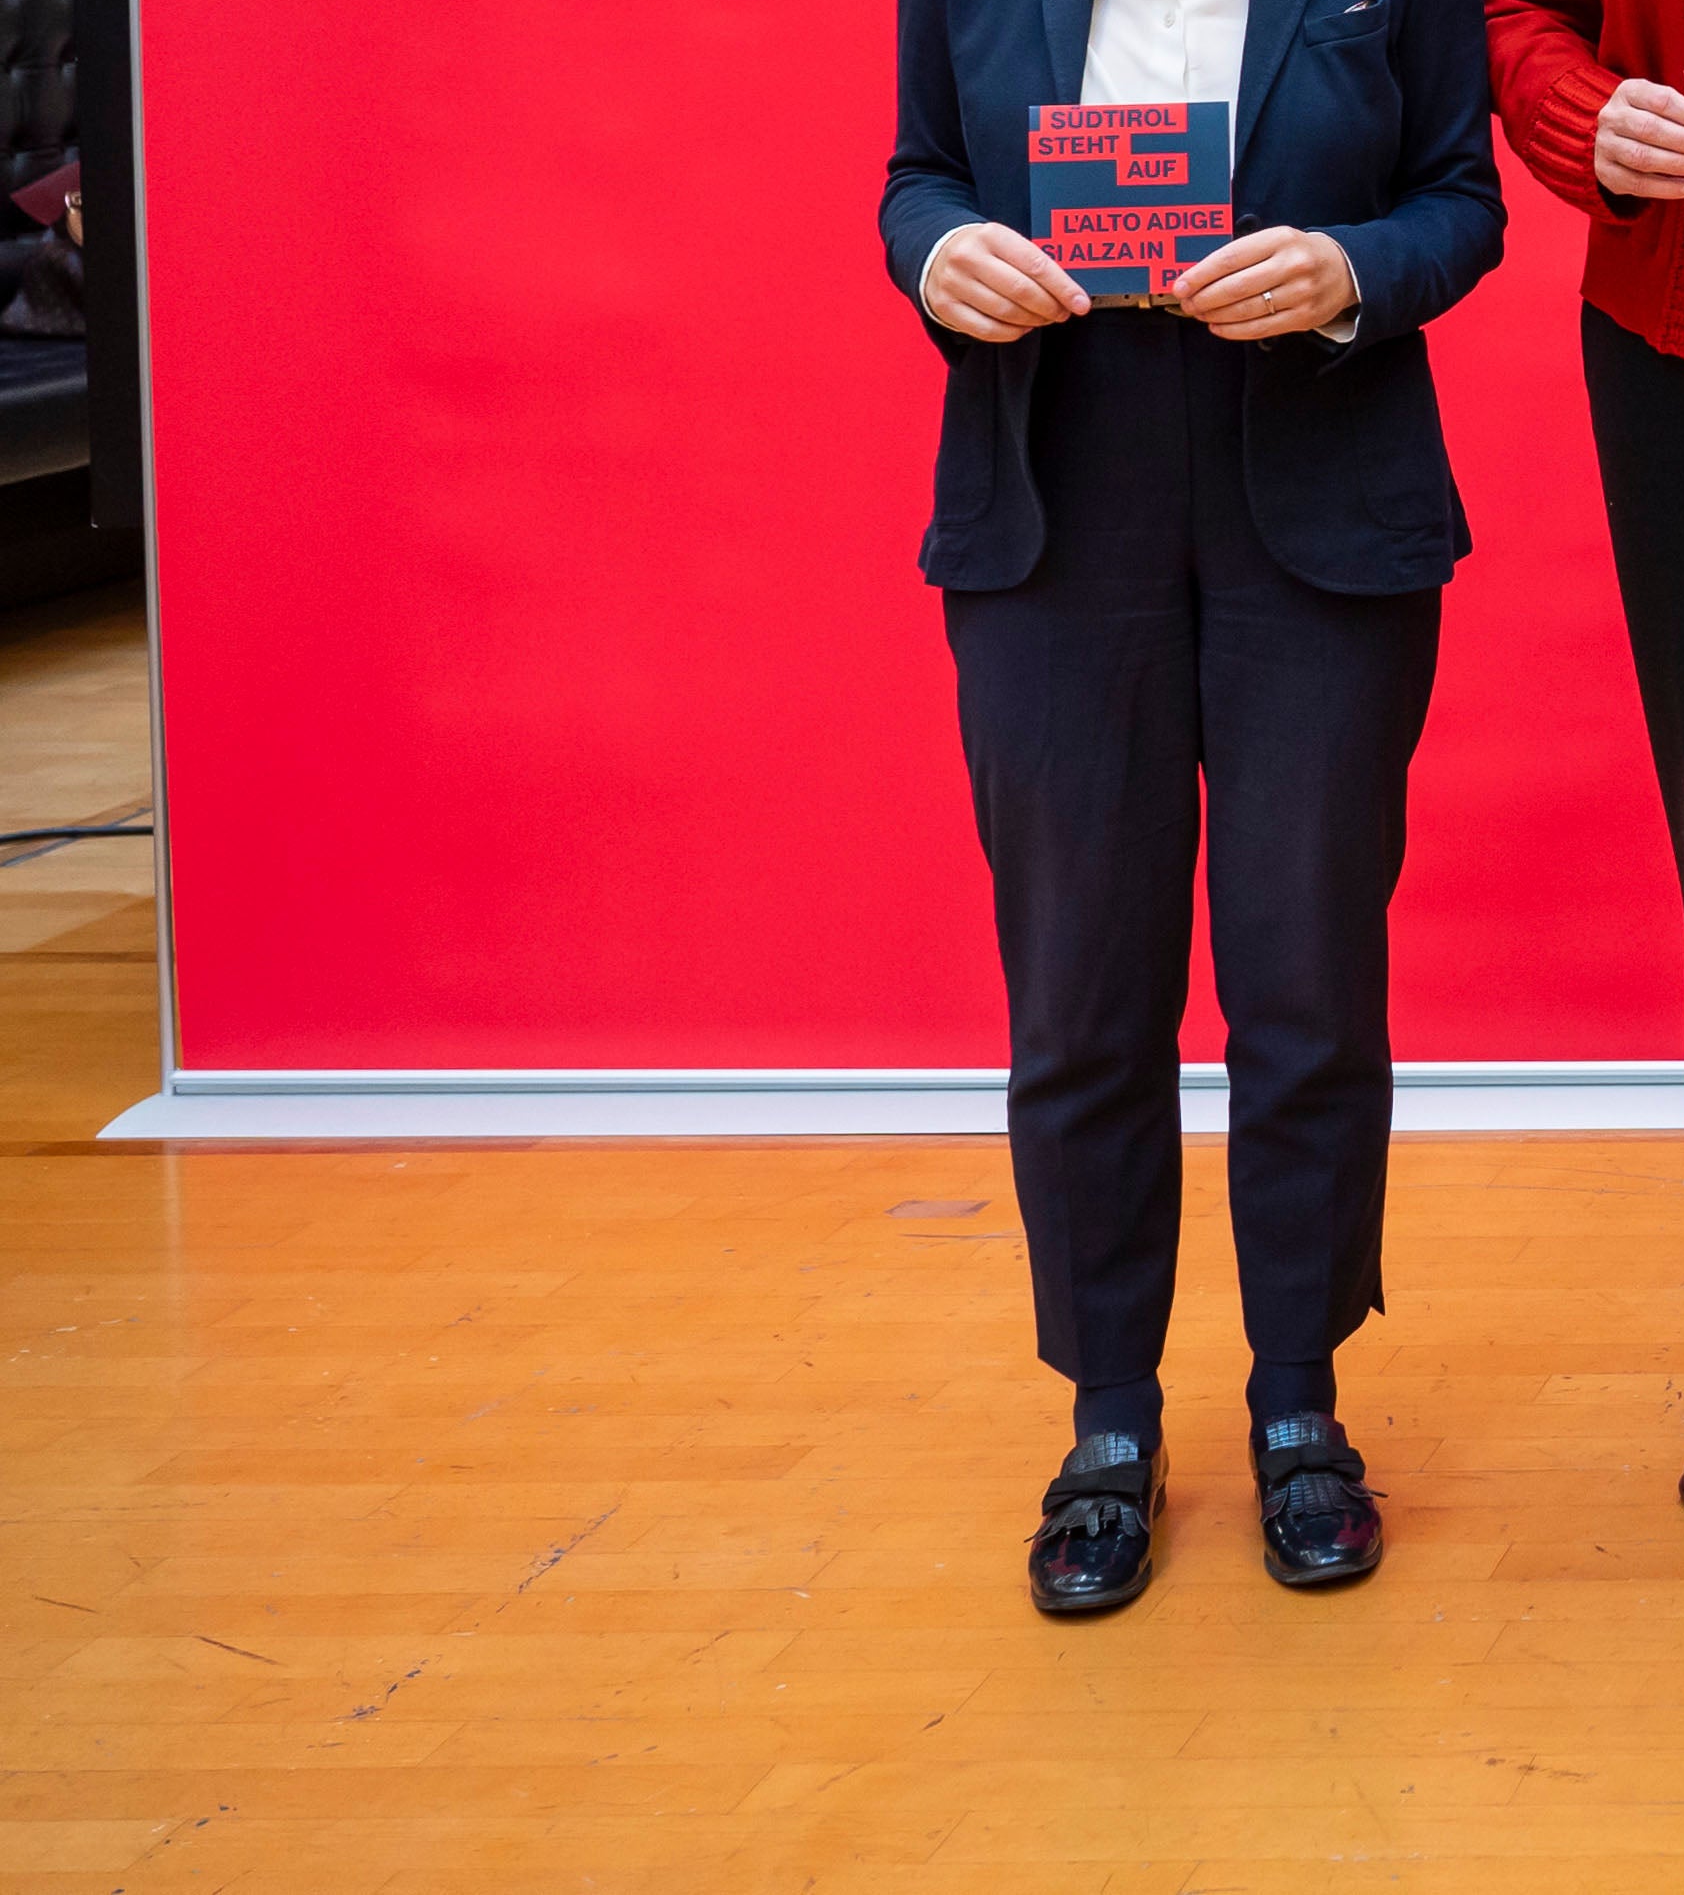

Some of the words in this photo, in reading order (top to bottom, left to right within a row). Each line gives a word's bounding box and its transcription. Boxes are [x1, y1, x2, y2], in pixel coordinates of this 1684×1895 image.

[1050, 106, 1177, 130] SÜDTIROL
[1038, 134, 1120, 156] STEHT
[1127, 159, 1177, 179] AUF
[1063, 212, 1141, 234] L'ALTO
[1146, 210, 1225, 231] ADIGE
[1068, 242, 1135, 262] ALZA
[1139, 240, 1164, 259] IN
